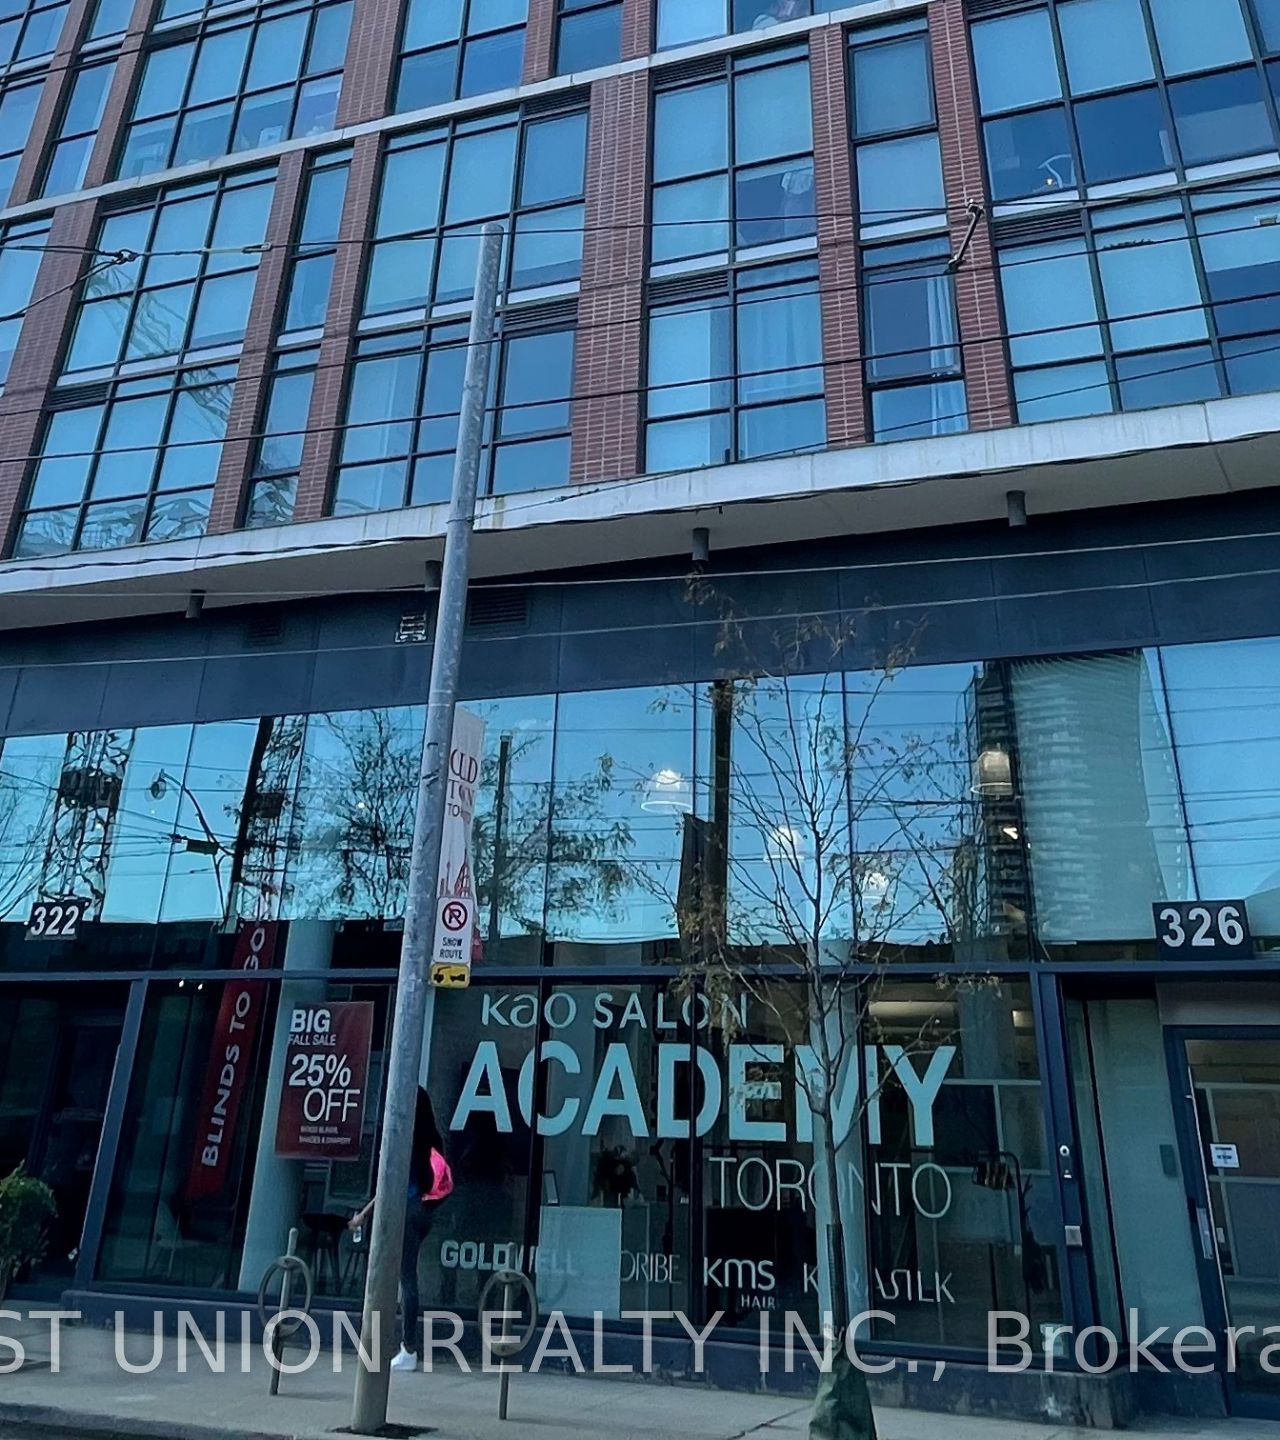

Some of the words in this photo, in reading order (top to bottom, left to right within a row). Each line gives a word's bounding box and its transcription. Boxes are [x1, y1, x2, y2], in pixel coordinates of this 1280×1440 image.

[31, 905, 79, 937] 322
[1159, 905, 1244, 948] 326
[439, 949, 463, 960] ROUTE
[442, 937, 463, 947] SNOW
[289, 1009, 331, 1034] BIG
[593, 992, 748, 1031] SALON
[288, 1034, 310, 1046] FALL
[312, 1034, 337, 1047] SALE
[201, 1044, 241, 1168] BLINDS
[229, 991, 251, 1035] TO
[288, 1054, 352, 1088] 25%
[303, 1088, 361, 1123] OFF
[449, 1040, 957, 1147] ACADEMY
[620, 1250, 683, 1285] ORIBE
[803, 1262, 956, 1304] KASILK
[740, 1294, 776, 1310] HAIR
